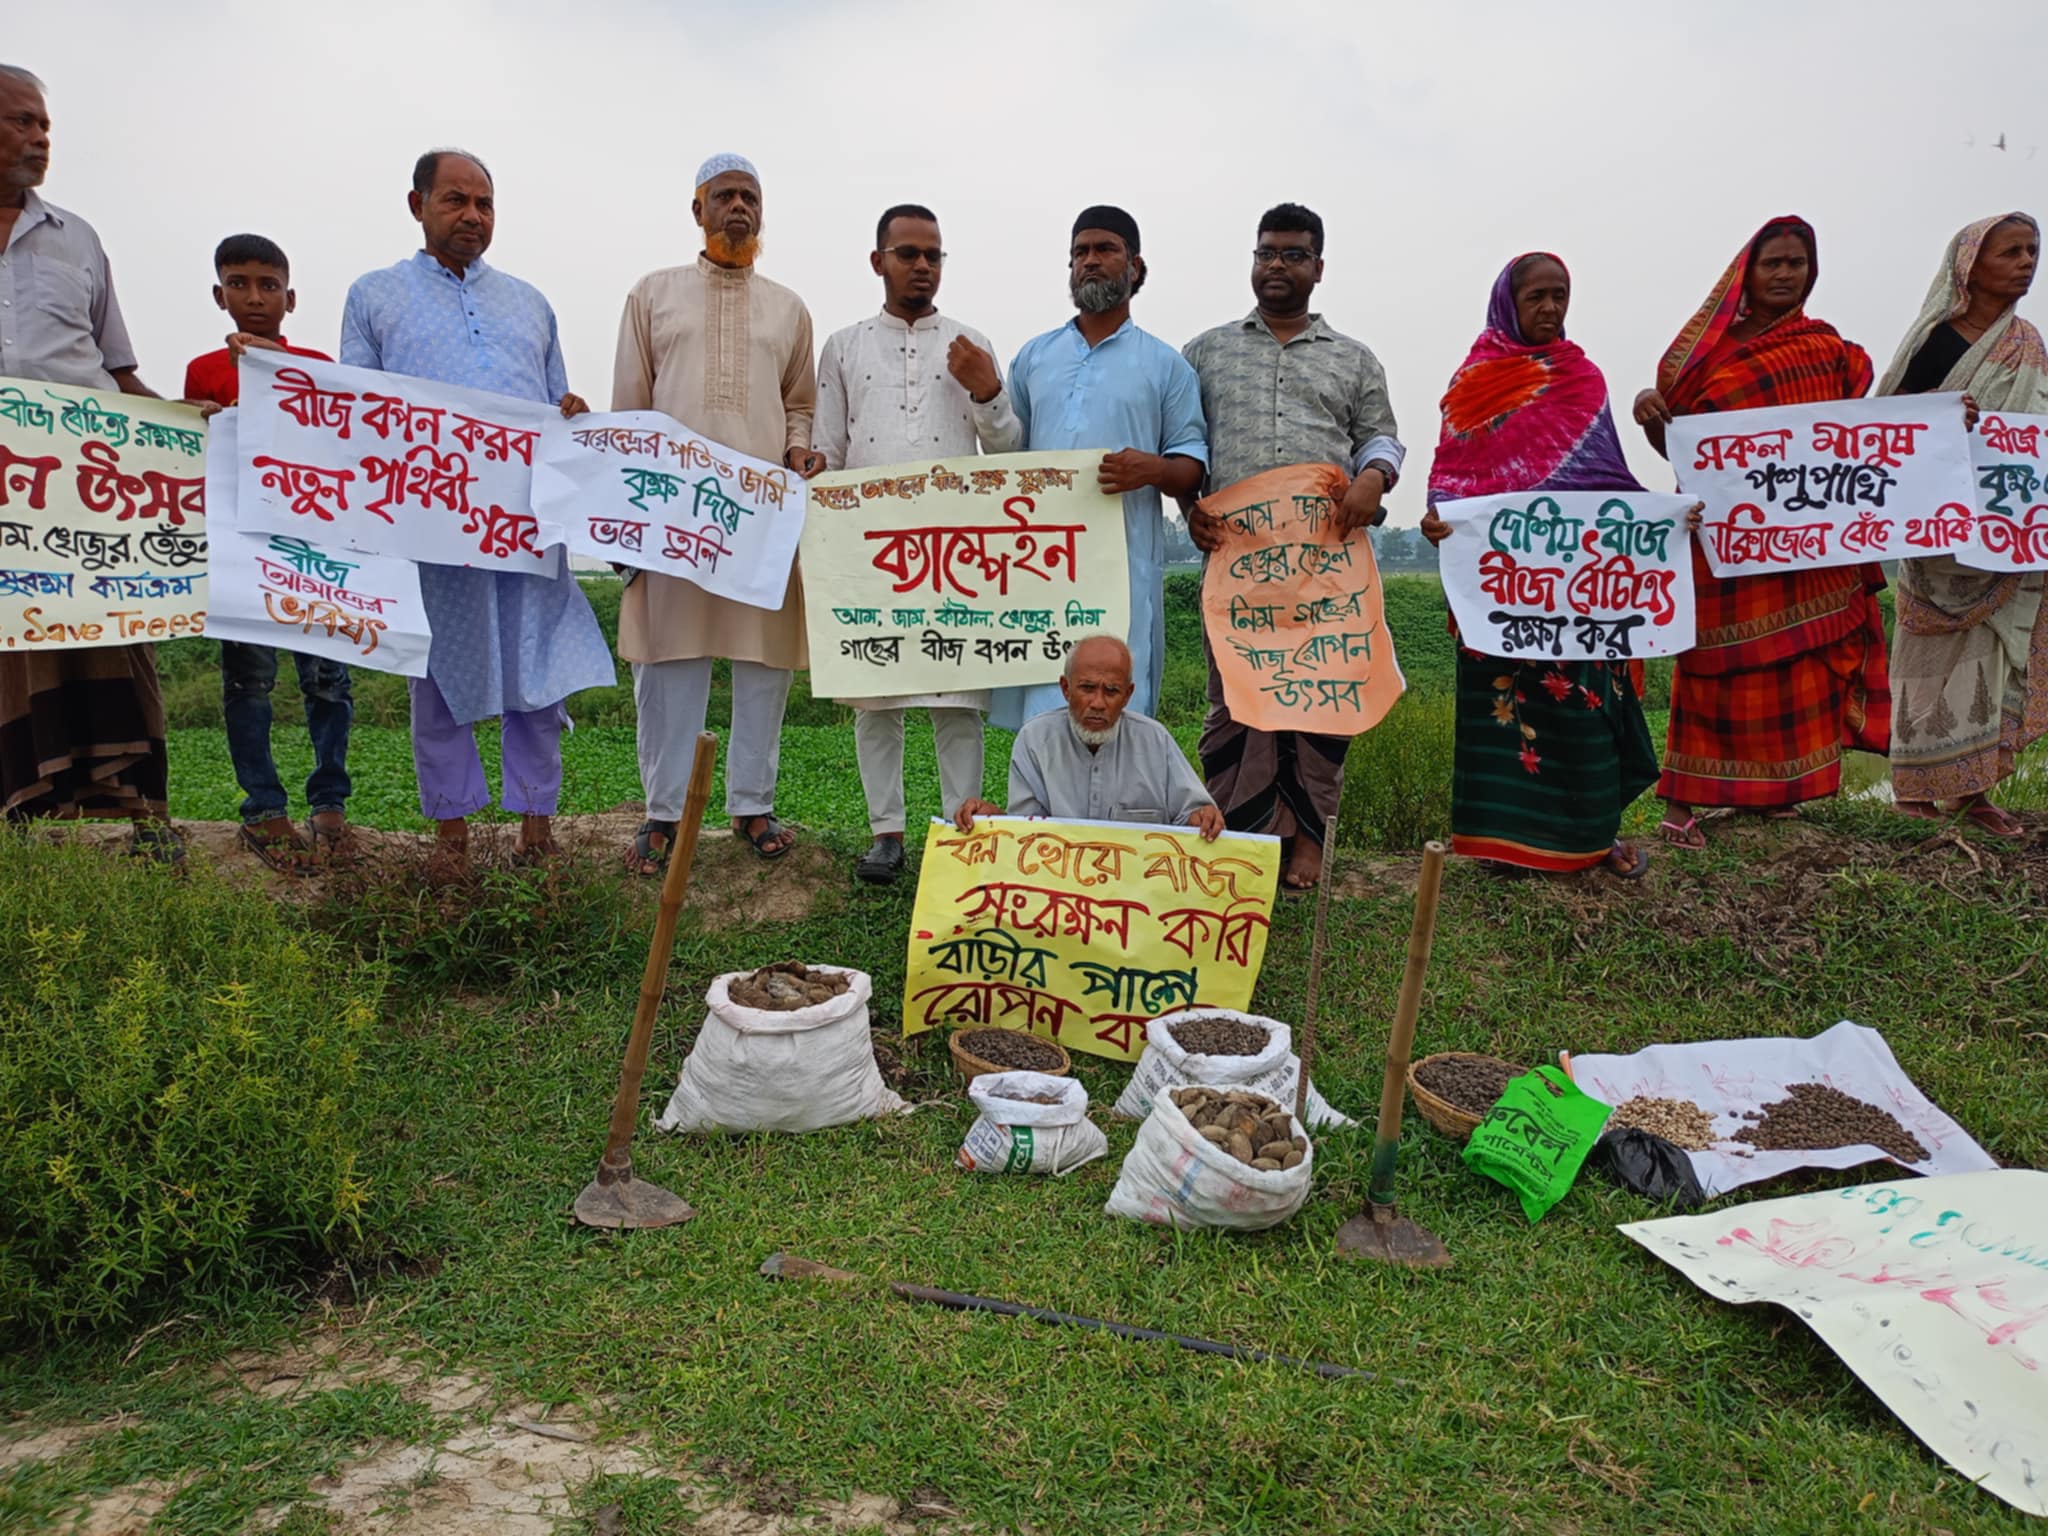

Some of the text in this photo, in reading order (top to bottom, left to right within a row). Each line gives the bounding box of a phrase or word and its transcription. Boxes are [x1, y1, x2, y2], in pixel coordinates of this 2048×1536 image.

[272, 367, 356, 439] বীজ
[452, 413, 541, 466] করব
[1980, 415, 2040, 458] বীজ
[1694, 422, 1928, 470] সকল মানুষ
[253, 456, 356, 521] নতুন
[360, 444, 478, 524] পৃথিবী
[621, 468, 754, 535] বৃক্ষ দিয়ে
[1977, 464, 2041, 516] বৃক্ষ
[588, 517, 733, 574] ভরে তুলি
[864, 495, 1087, 598] ক্যাম্পেইন
[1596, 498, 1675, 562] বীজ
[1840, 512, 1894, 553] বেঁচে
[1905, 502, 1976, 548] থাকি
[268, 535, 360, 588] বীজ
[1479, 551, 1565, 612] বীজ
[23, 607, 206, 642] Save Trees
[1065, 600, 1106, 627] নিম
[1227, 594, 1285, 632] নিম
[1488, 611, 1646, 658] রক্ষা কর
[841, 637, 904, 666] গাছের
[921, 629, 967, 666] বীজ
[974, 638, 1032, 664] বপন
[1260, 671, 1370, 712] উৎসব
[1143, 832, 1266, 905] বীজ
[1158, 900, 1271, 966] করি
[928, 928, 1200, 1014] বাড়ীর পাশে
[912, 982, 1082, 1037] রোপন
